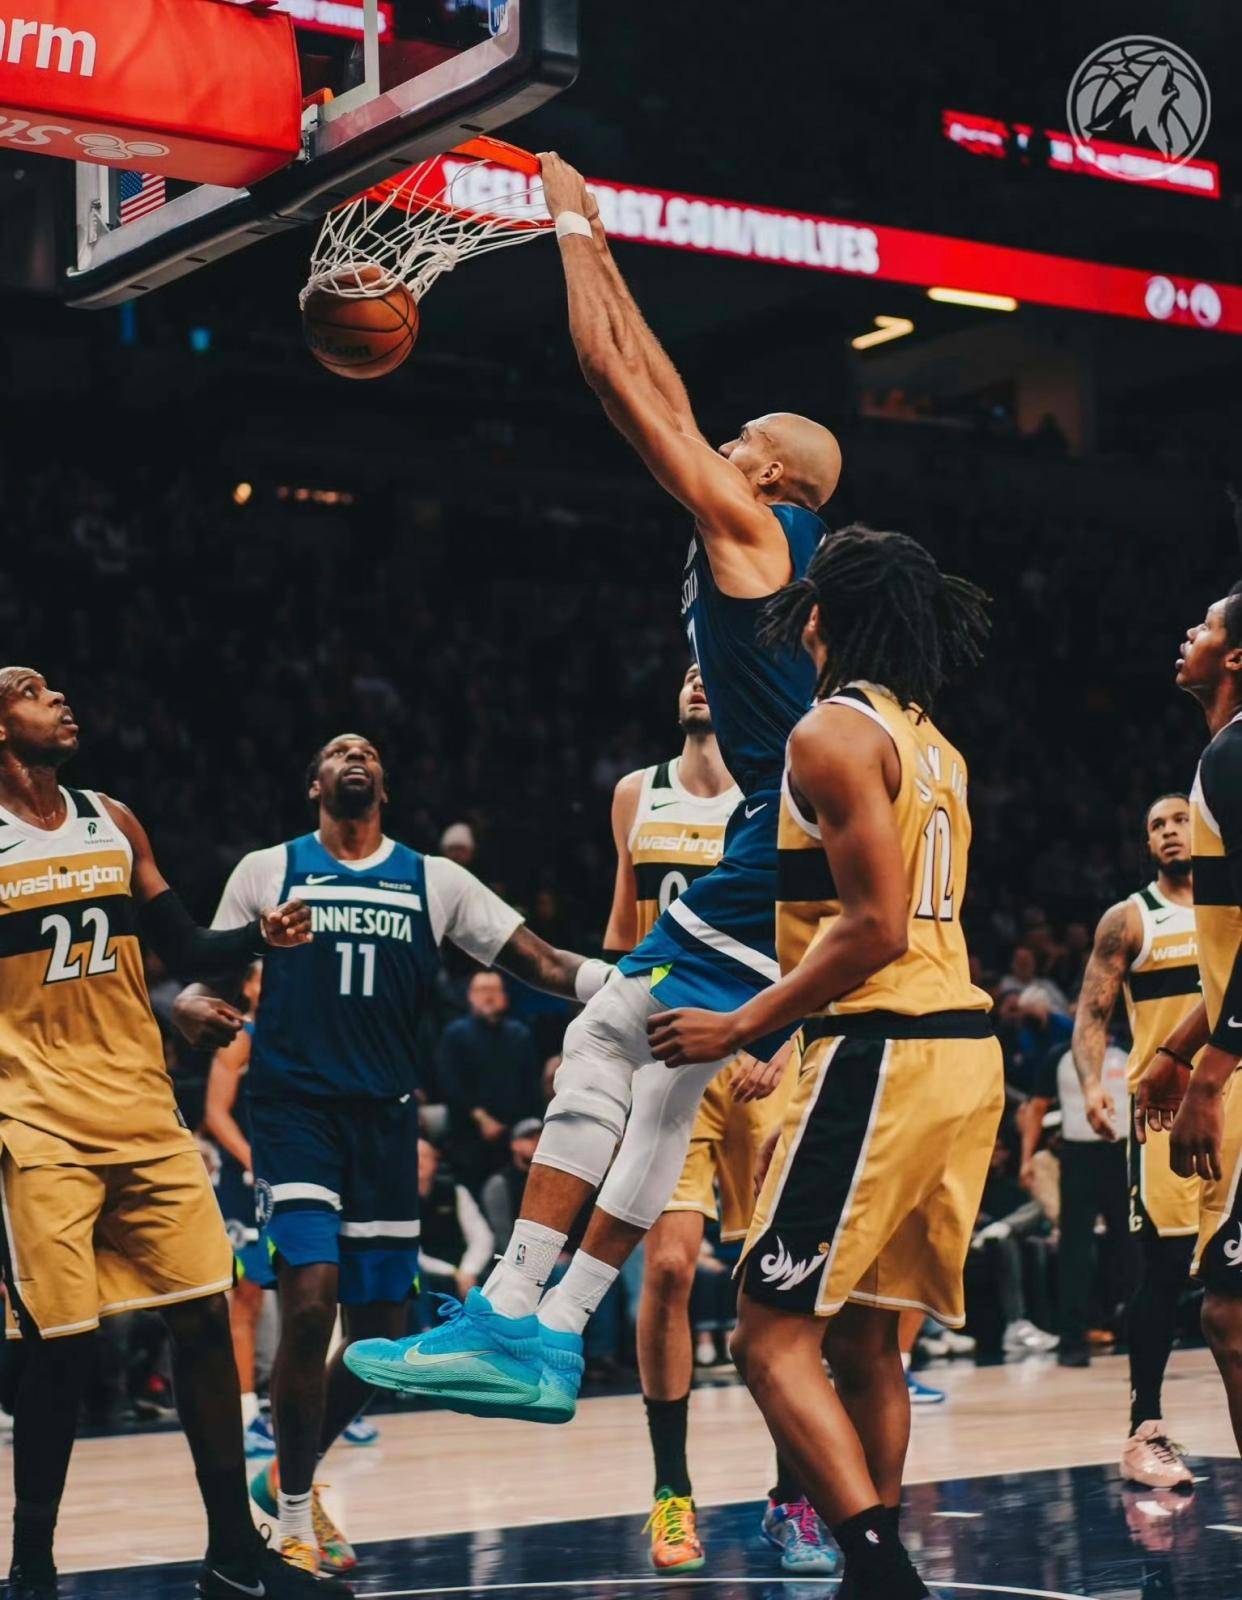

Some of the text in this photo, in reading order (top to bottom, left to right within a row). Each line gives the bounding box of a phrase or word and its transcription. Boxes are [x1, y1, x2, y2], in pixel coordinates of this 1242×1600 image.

[0, 18, 97, 77] rm
[0, 115, 73, 145] St
[638, 829, 723, 860] washing
[0, 864, 124, 901] washington
[311, 906, 412, 943] INNESOTA
[41, 907, 118, 985] 22
[336, 942, 376, 996] 11
